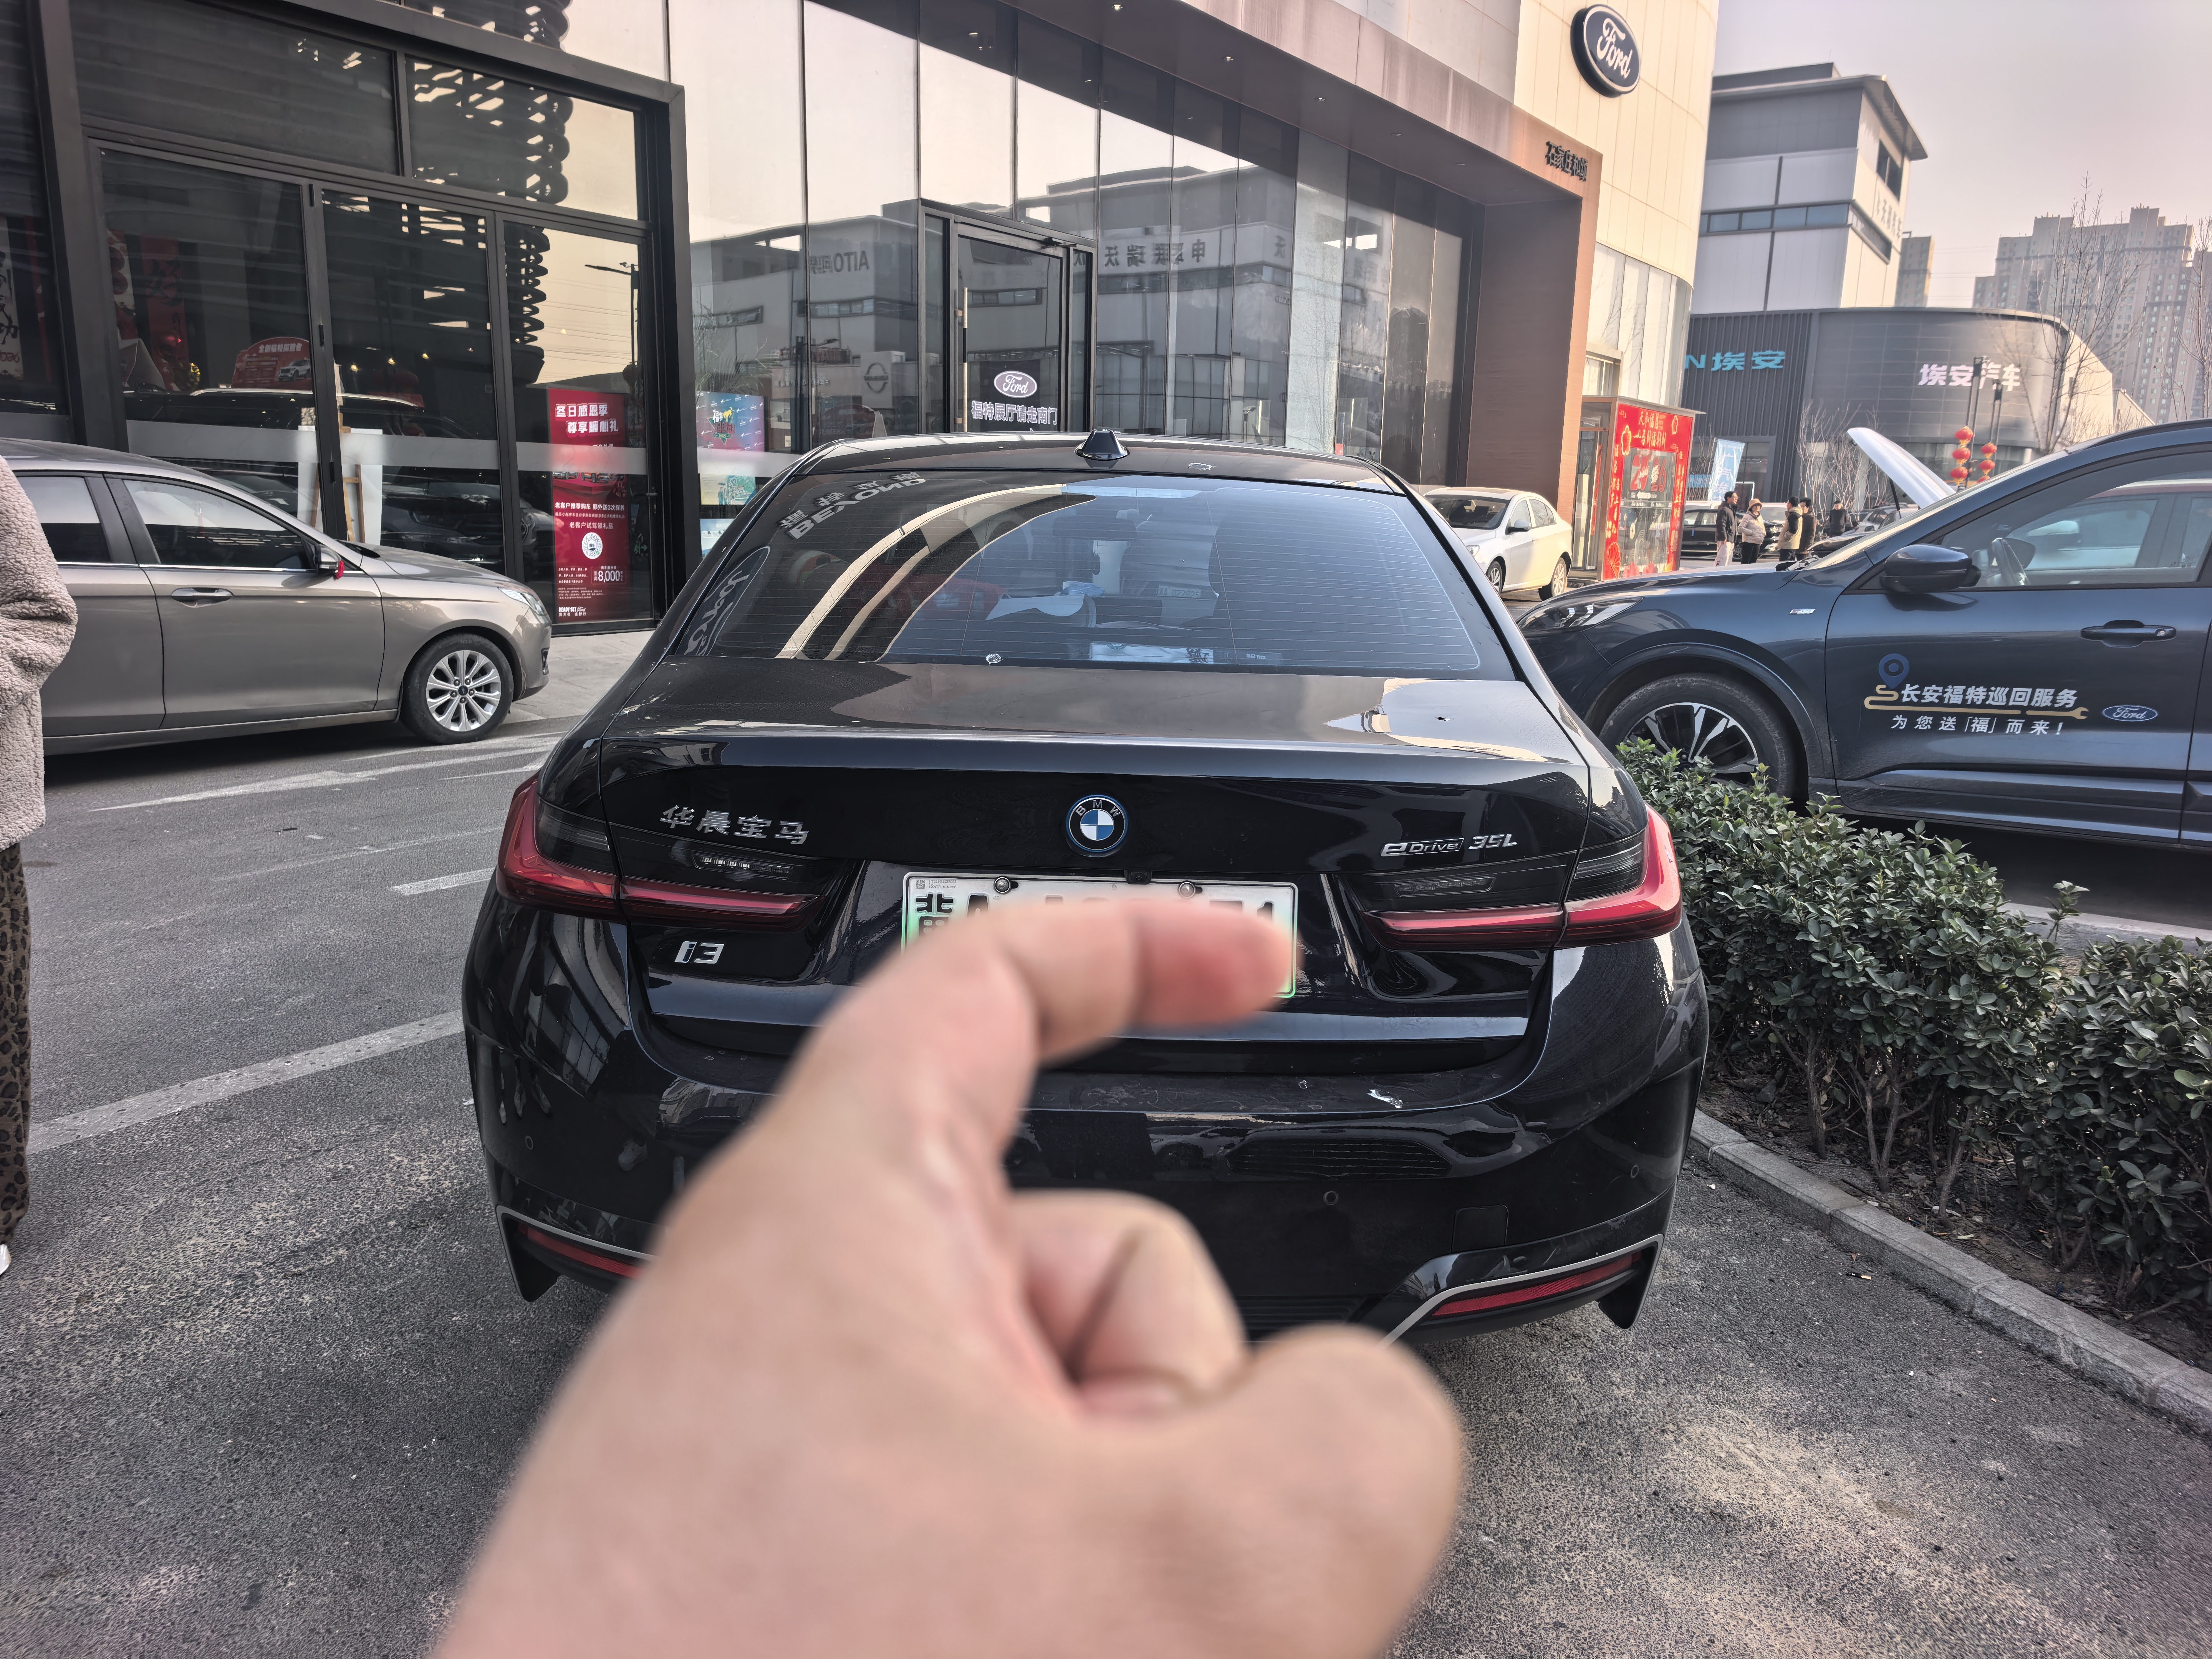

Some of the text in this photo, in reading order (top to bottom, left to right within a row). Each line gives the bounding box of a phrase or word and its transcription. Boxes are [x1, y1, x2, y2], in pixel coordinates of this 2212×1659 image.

[1597, 18, 1633, 79] Ford
[1546, 142, 1588, 181] 石家庄和颂
[1002, 374, 1029, 394] Ford
[1918, 362, 2020, 391] 埃安汽车
[556, 404, 608, 417] 冬日感恩季
[971, 400, 1058, 425] 福特展厅请走南门
[567, 420, 619, 434] 尊享暖心礼
[593, 503, 625, 511] 额外送3次保养
[569, 522, 614, 530] 老客户试驾领礼品
[598, 570, 620, 583] 8,000
[1900, 683, 2078, 708] 长安福特巡回服务
[2113, 707, 2147, 719] Ford
[1075, 800, 1121, 817] BMW
[660, 805, 810, 845] 华晨宝马
[1381, 833, 1518, 857] eDrive 35L
[674, 940, 725, 964] i3
